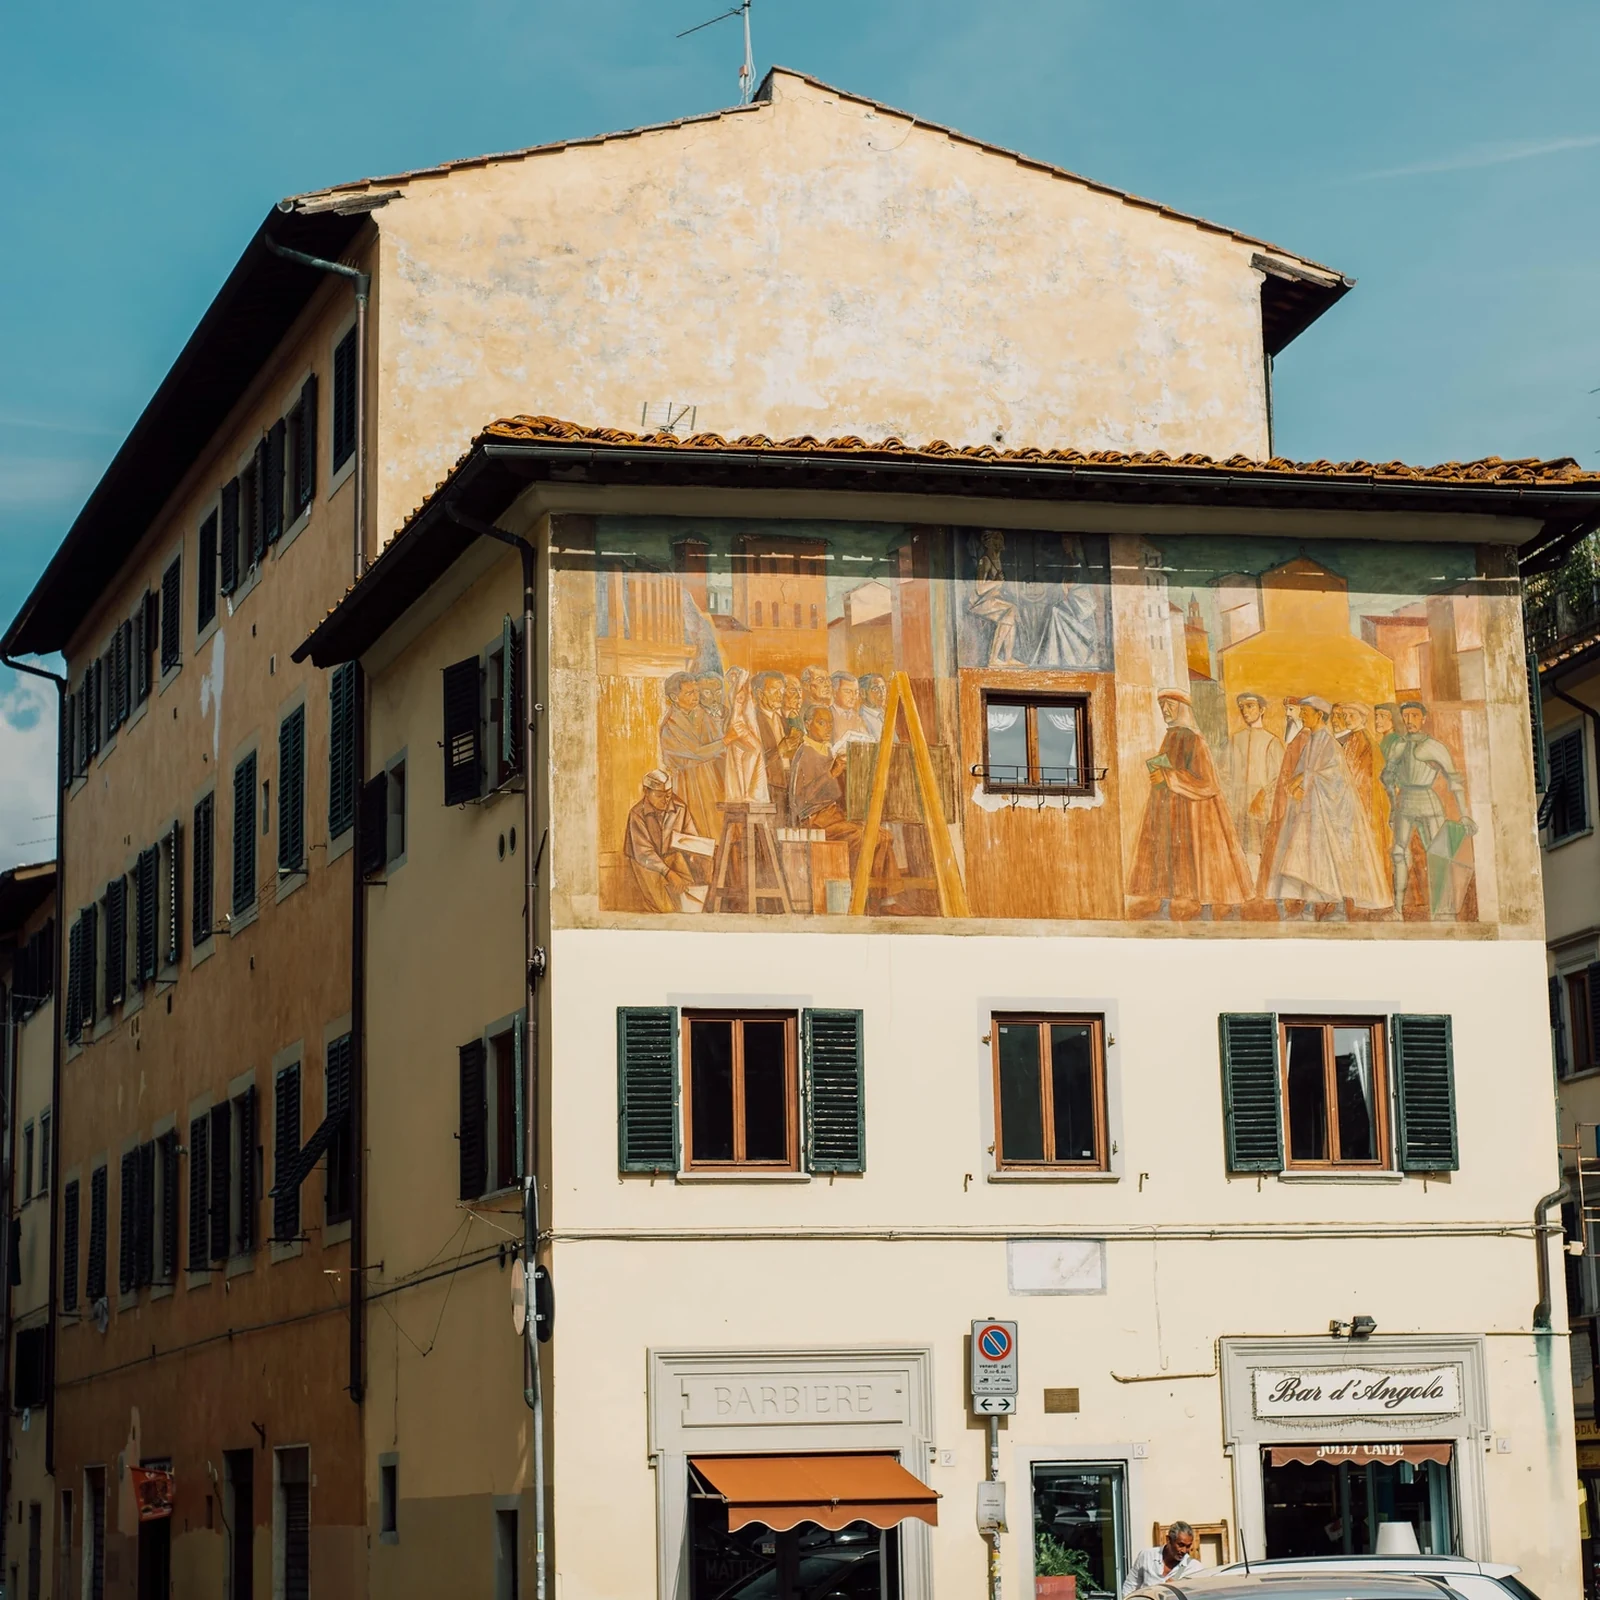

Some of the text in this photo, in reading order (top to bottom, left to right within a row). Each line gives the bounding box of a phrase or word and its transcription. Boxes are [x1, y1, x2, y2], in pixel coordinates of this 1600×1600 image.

[714, 1385, 873, 1415] BARBIERE
[1269, 1375, 1444, 1409] Bar d'Angolo
[944, 1453, 951, 1463] 2
[1137, 1445, 1144, 1456] 3
